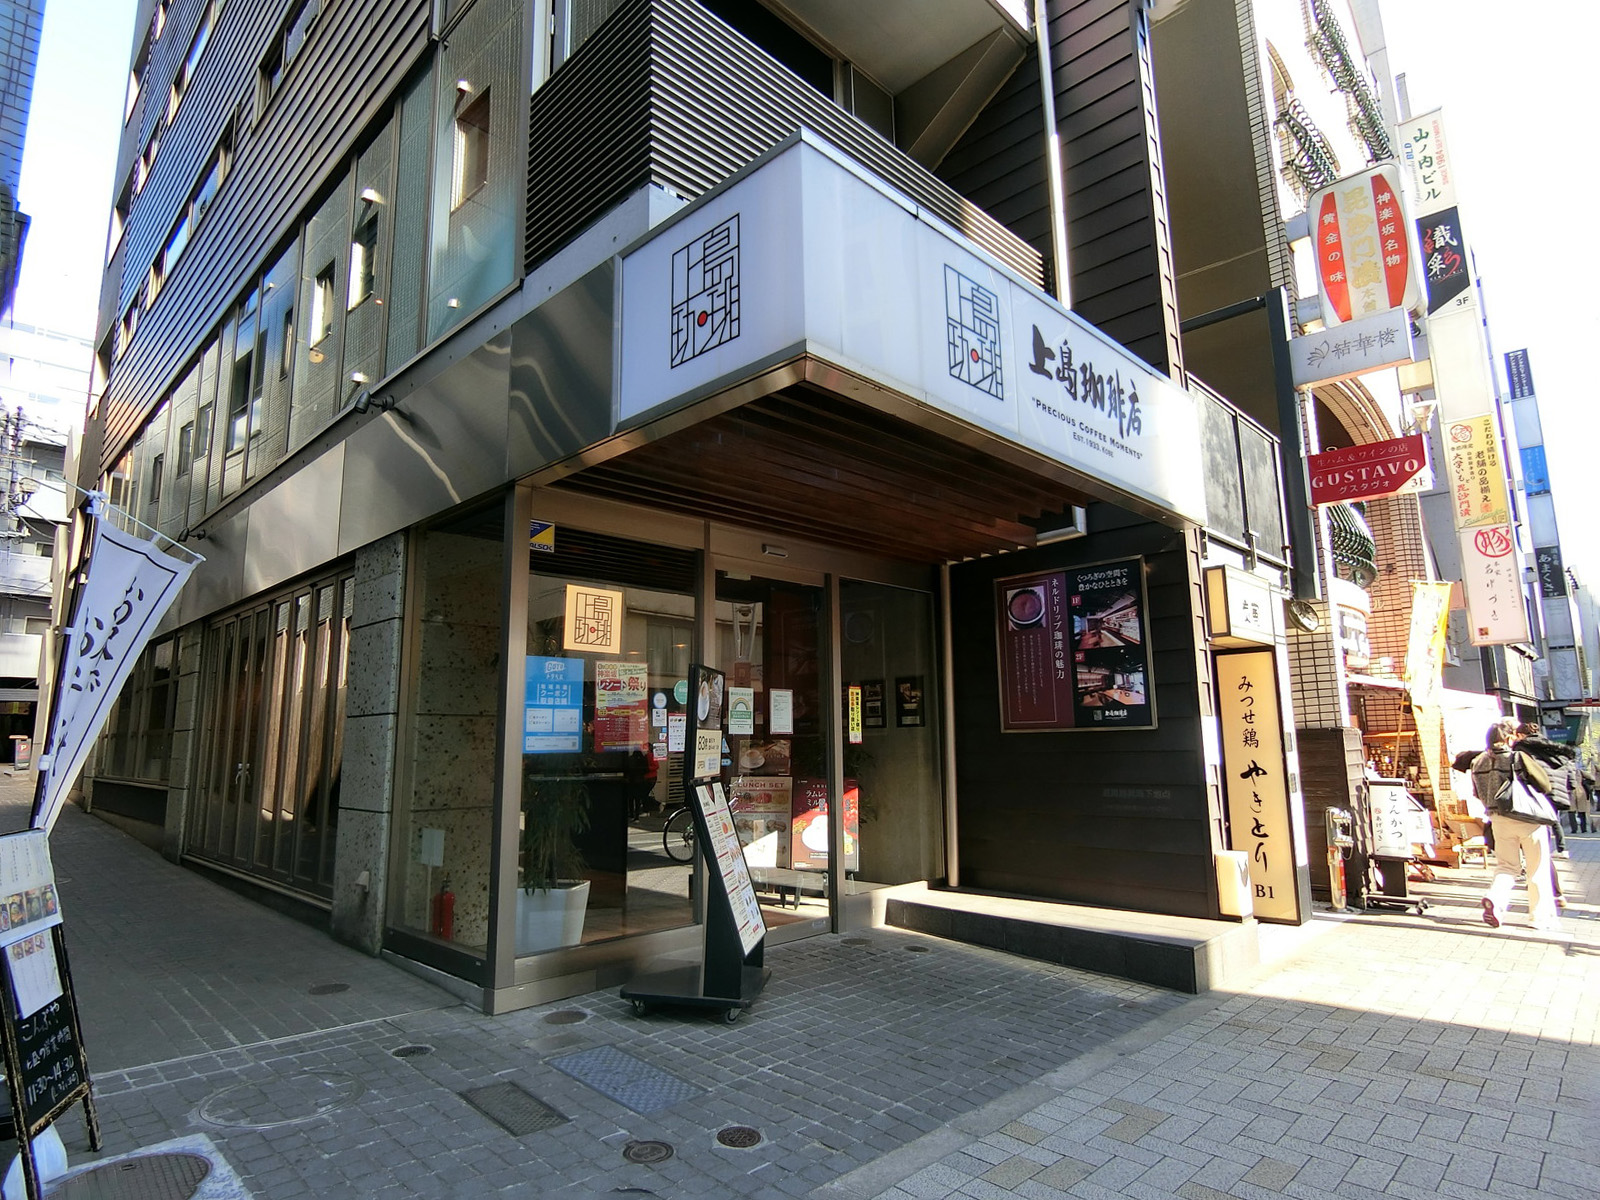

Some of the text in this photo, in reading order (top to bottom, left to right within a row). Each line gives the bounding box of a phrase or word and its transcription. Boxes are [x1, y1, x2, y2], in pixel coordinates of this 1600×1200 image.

[1413, 127, 1442, 201] 山ノ内ビル
[1435, 149, 1446, 169] 1984
[1322, 212, 1345, 283] 黄金の味
[1376, 191, 1401, 267] 神楽坂名物
[1456, 296, 1469, 307] 3F
[1029, 324, 1142, 439] 上島珈琲店
[1312, 458, 1419, 489] GUSTAVO
[1339, 480, 1390, 494] グスタヴォ
[1475, 450, 1491, 503] 老舗の品揃え
[1077, 568, 1128, 582] くつろぎの空間で
[1078, 578, 1128, 592] 豊かなひとときを
[1051, 578, 1065, 680] ネルドリップ珈琲の魅力
[1238, 676, 1269, 873] みつせ鶏 やきとり
[1374, 815, 1382, 842] あげづき
[1388, 791, 1403, 838] とんかつ
[1254, 884, 1275, 899] B1
